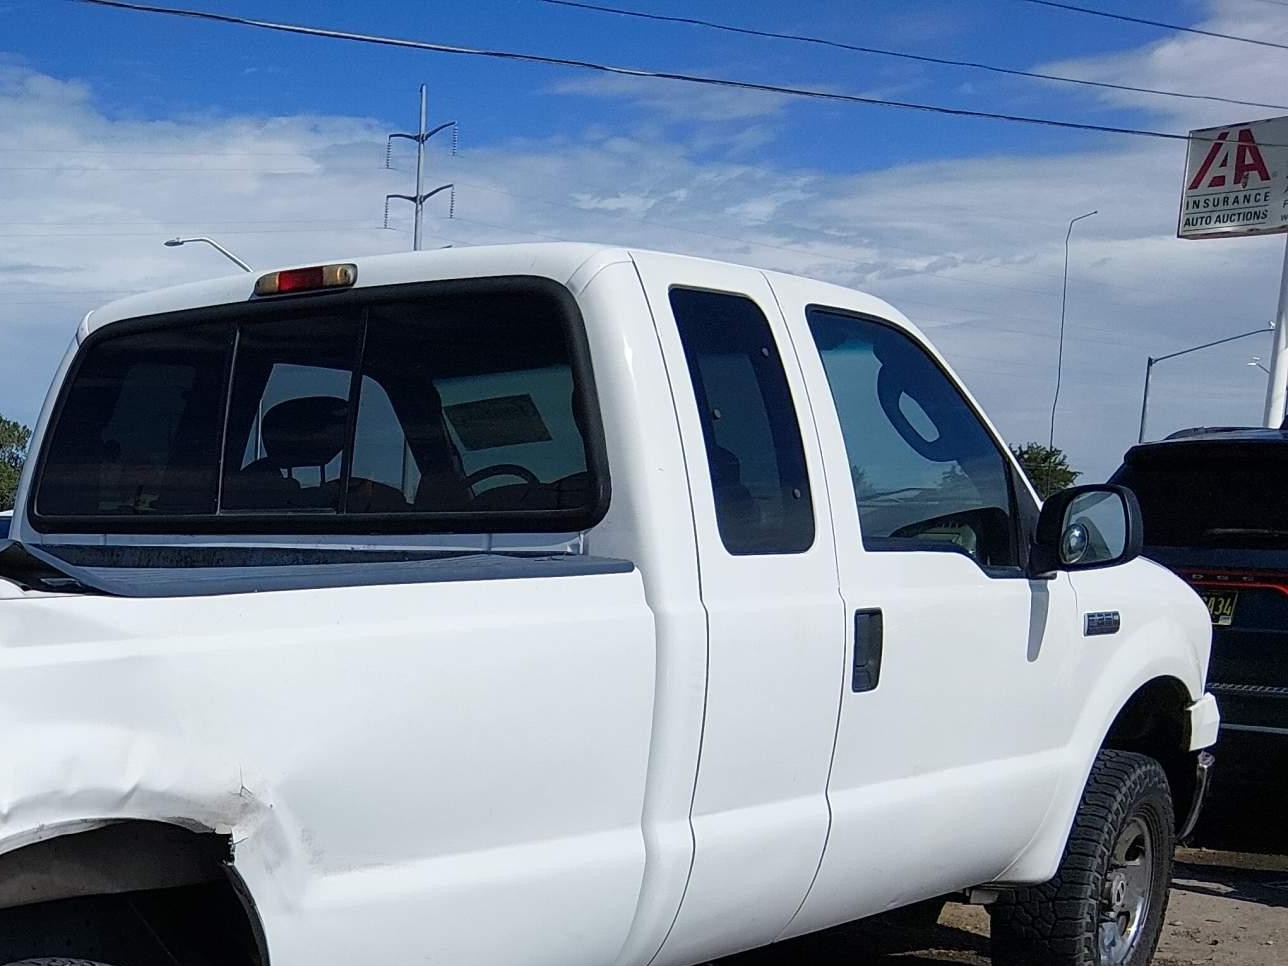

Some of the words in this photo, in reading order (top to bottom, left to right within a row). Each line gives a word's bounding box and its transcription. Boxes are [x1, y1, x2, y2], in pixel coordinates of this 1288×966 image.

[1185, 191, 1271, 211] INSURANCE
[1183, 215, 1212, 227] AUTO
[1214, 209, 1268, 225] AUCTIONS
